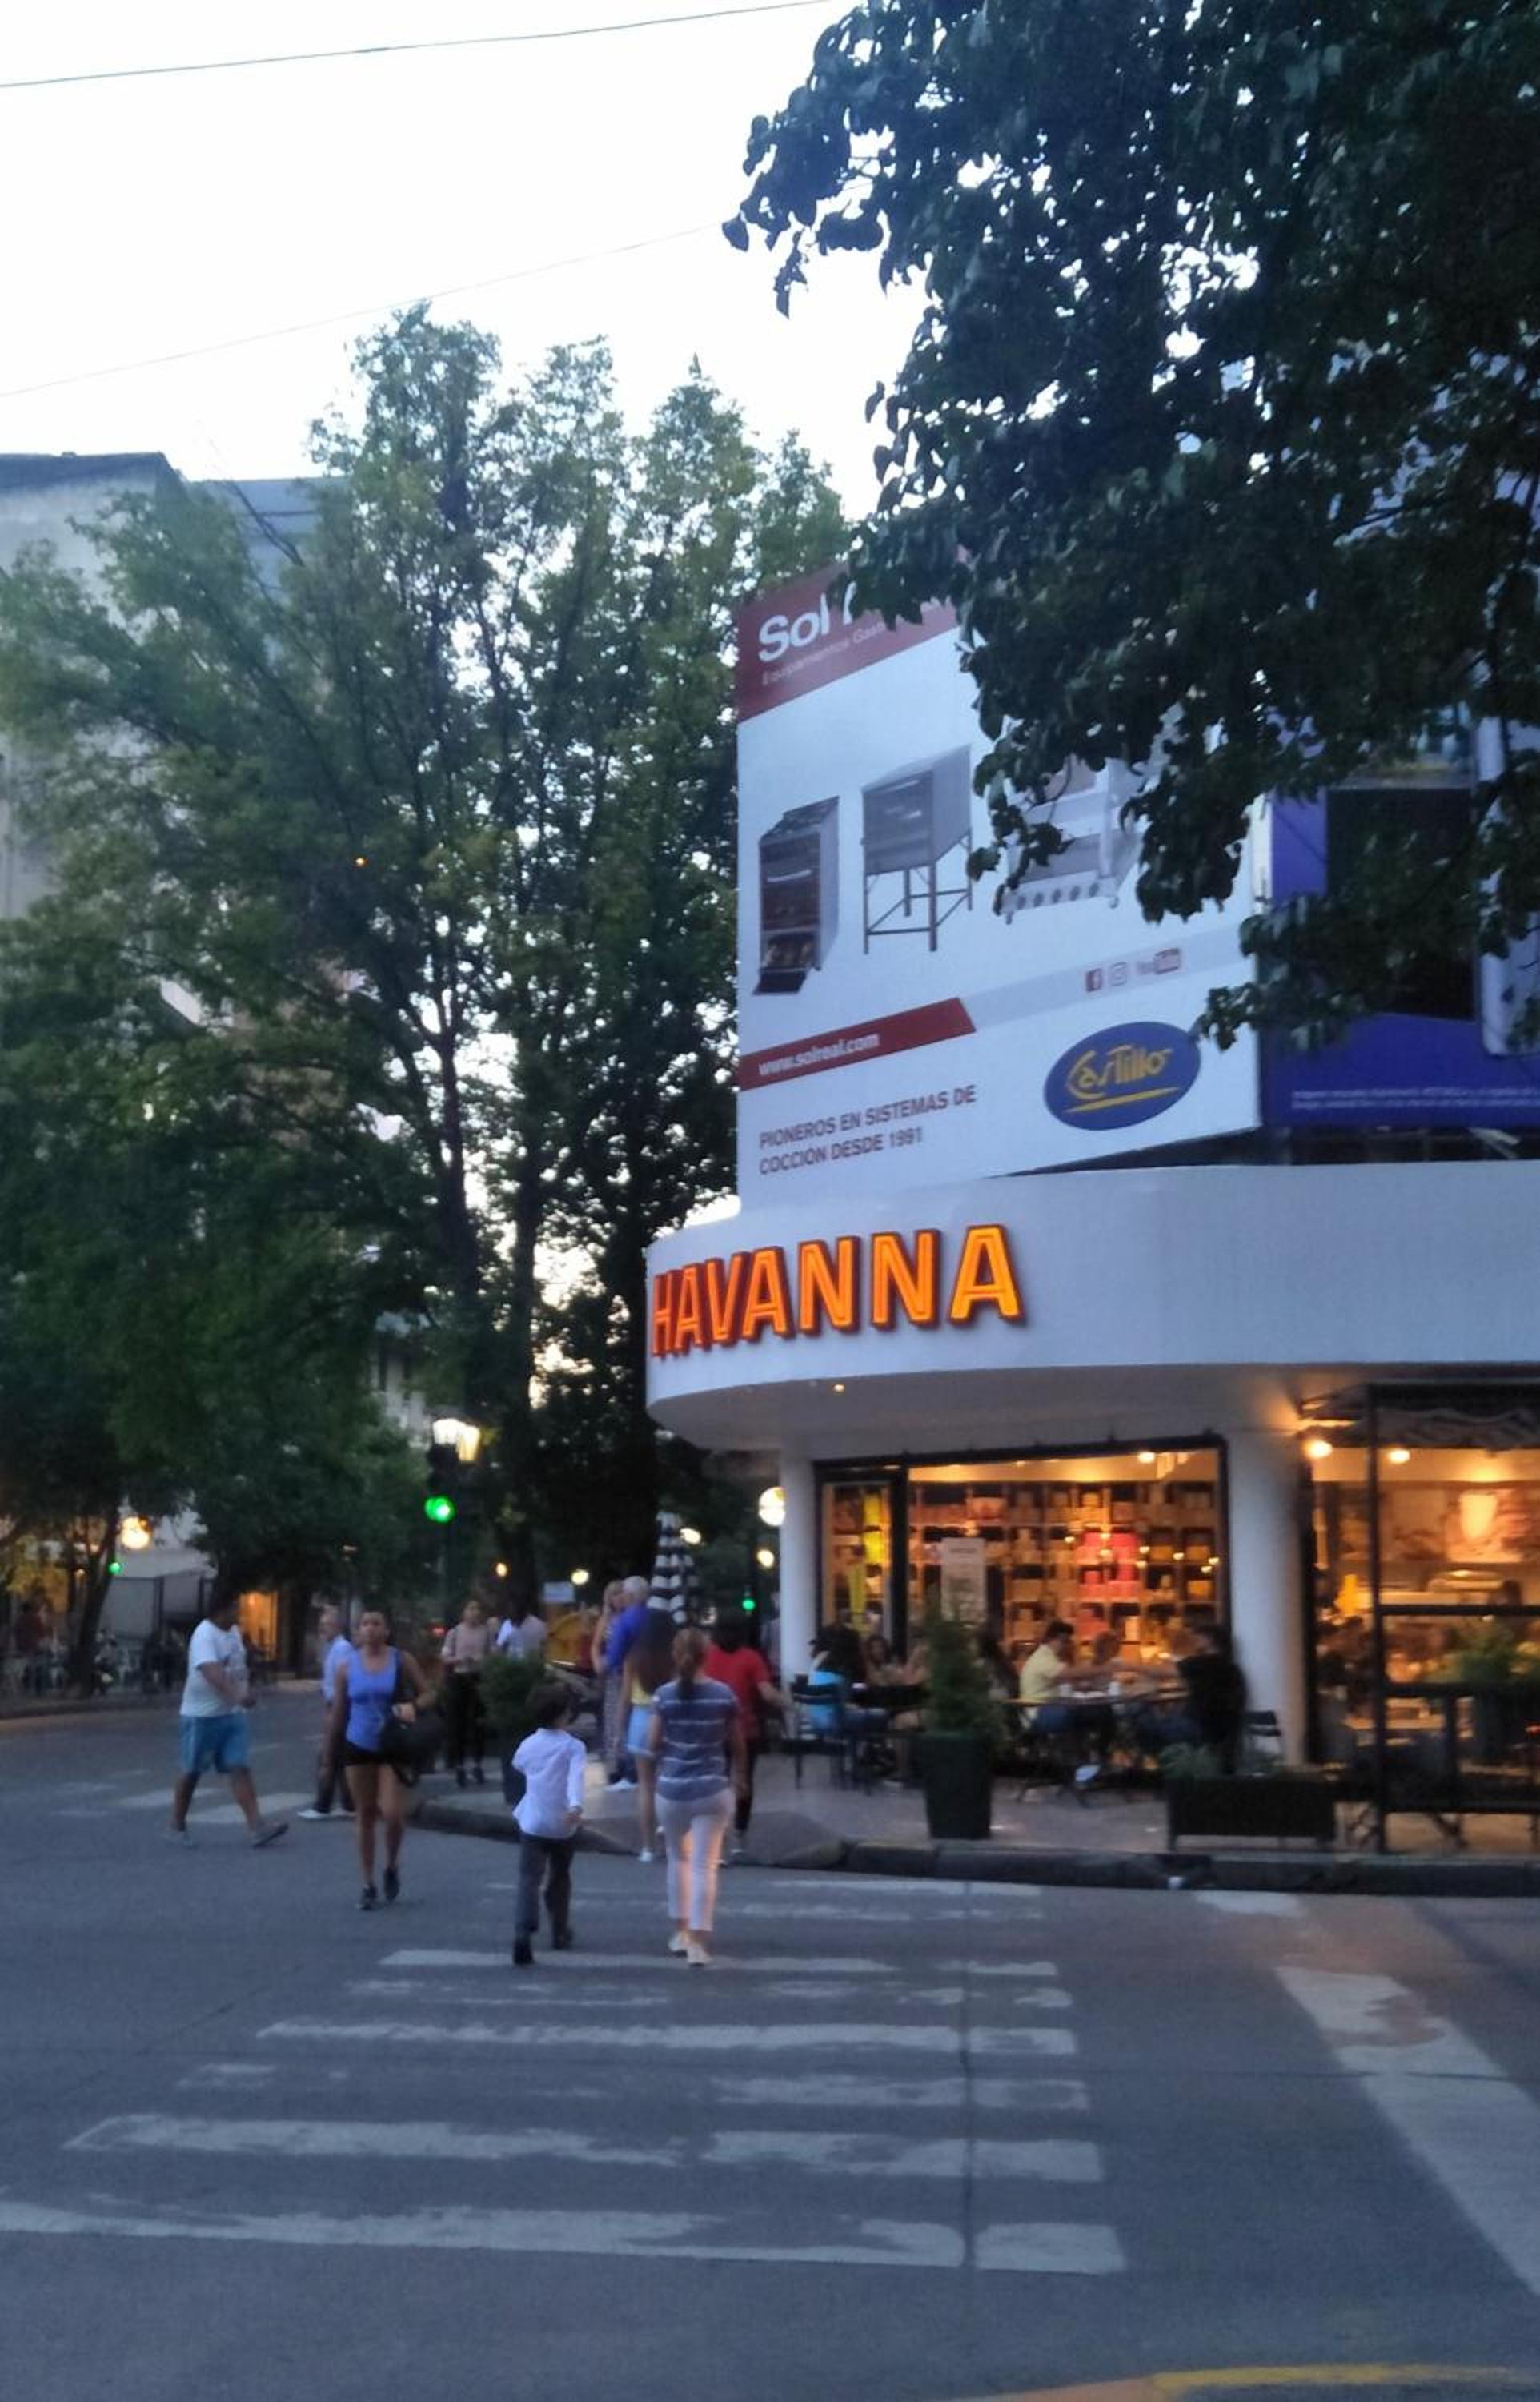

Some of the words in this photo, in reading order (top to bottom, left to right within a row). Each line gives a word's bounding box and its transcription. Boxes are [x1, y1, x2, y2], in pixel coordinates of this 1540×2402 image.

[759, 593, 830, 661] Sol
[759, 1116, 836, 1148] PIONEROS
[840, 1111, 862, 1131] EN
[865, 1091, 948, 1126] SISTEMAS
[953, 1084, 977, 1105] DE
[831, 1134, 884, 1160] DESDE
[651, 1223, 1025, 1360] HAVANNA
